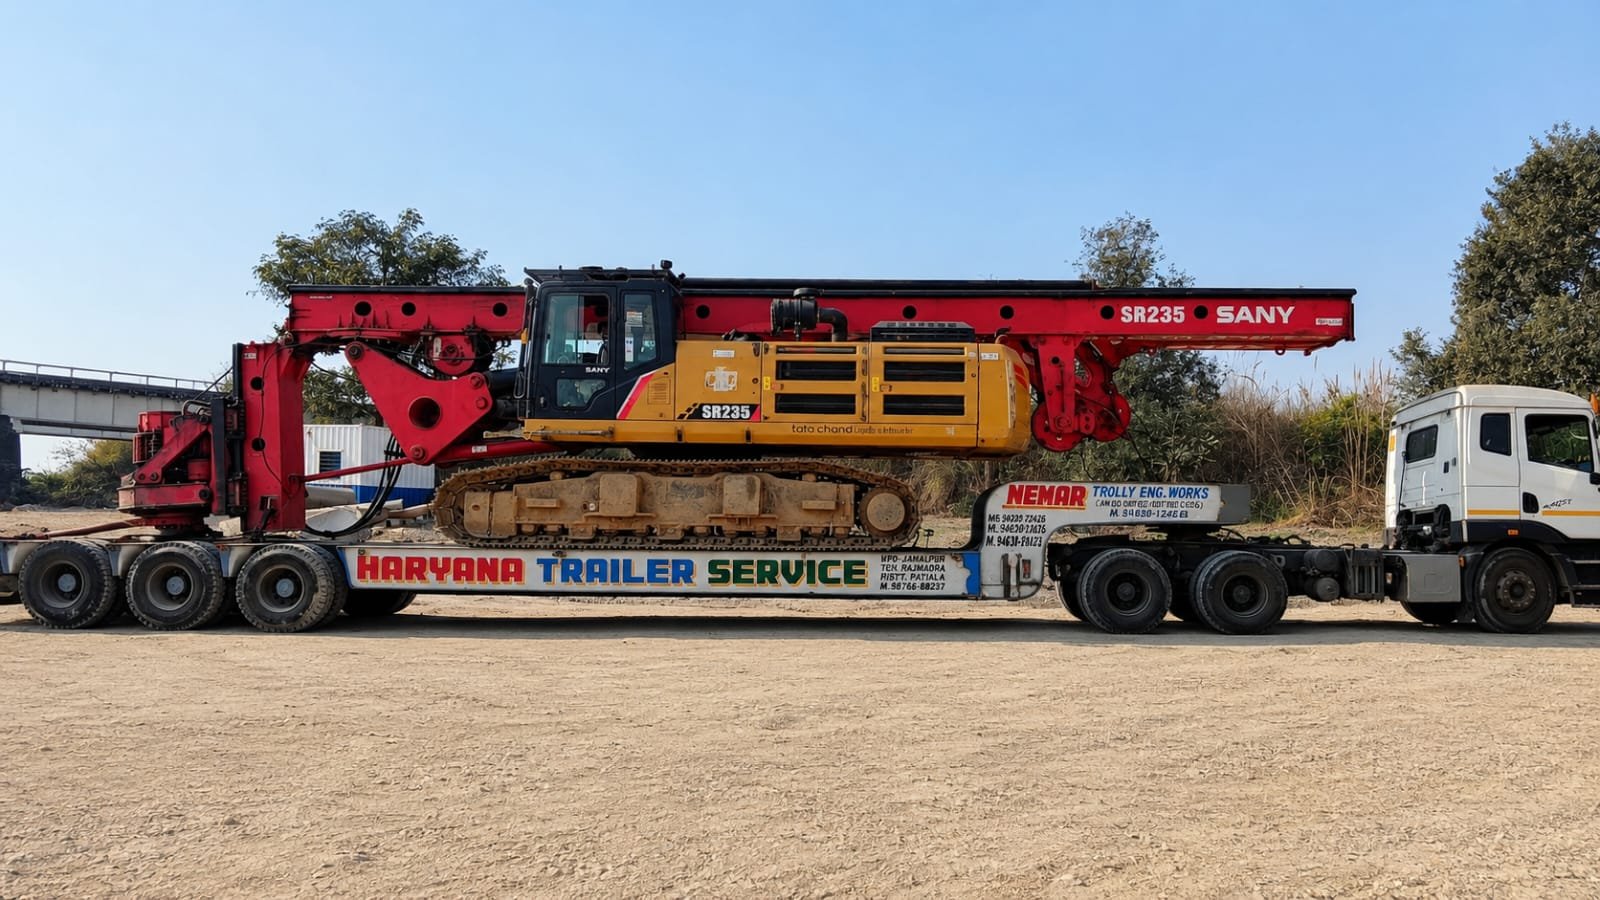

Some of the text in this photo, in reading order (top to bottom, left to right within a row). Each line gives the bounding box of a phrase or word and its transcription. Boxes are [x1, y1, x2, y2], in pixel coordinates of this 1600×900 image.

[1120, 305, 1185, 323] SR235
[1216, 306, 1295, 324] SANY
[701, 405, 751, 420] SR235
[1006, 484, 1087, 508] NEMAR
[1093, 485, 1136, 498] TROLLY
[357, 556, 869, 587] HARYANA TRAILER SERVICE
